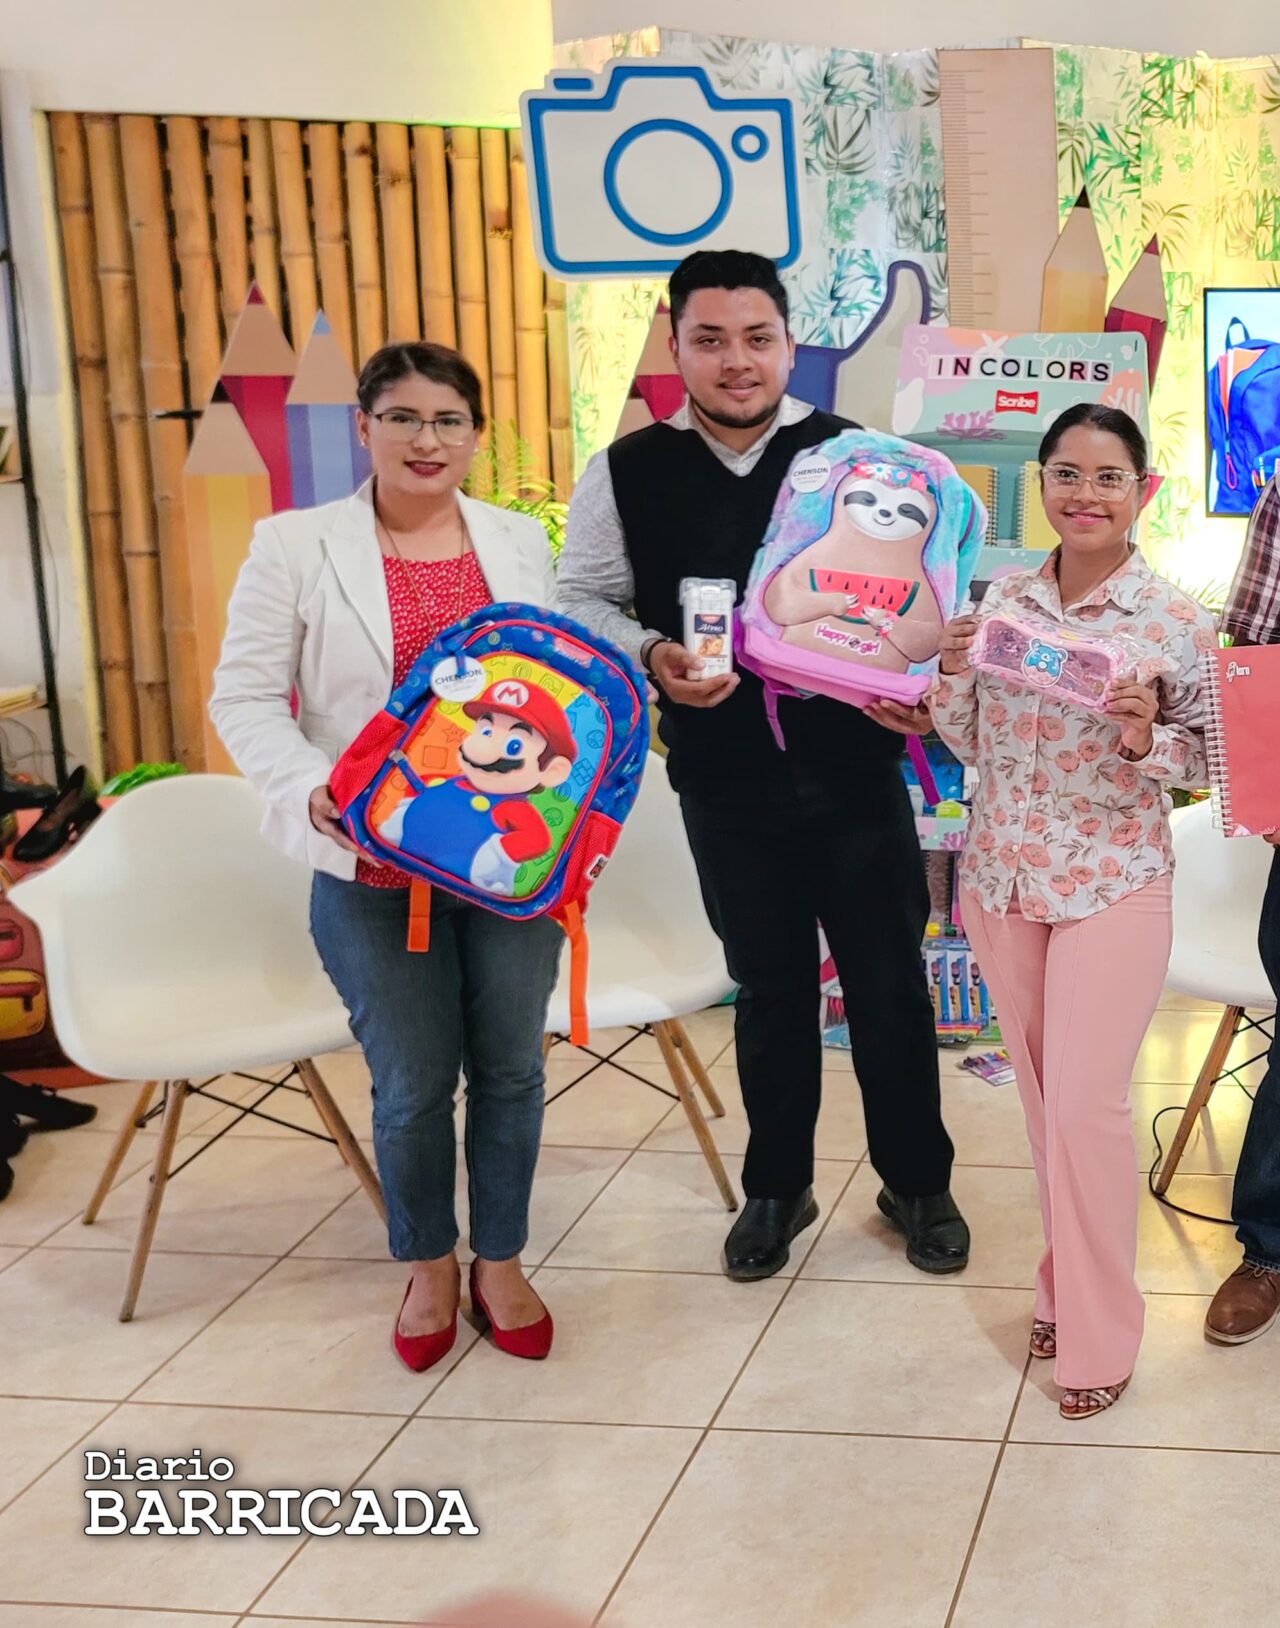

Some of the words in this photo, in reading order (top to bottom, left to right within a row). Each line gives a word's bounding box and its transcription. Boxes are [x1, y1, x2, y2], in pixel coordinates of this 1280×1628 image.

[938, 358, 970, 376] IN
[980, 358, 1109, 382] COLORS
[998, 395, 1036, 408] Scribe
[793, 467, 828, 477] CHENSON
[816, 625, 849, 644] Happy
